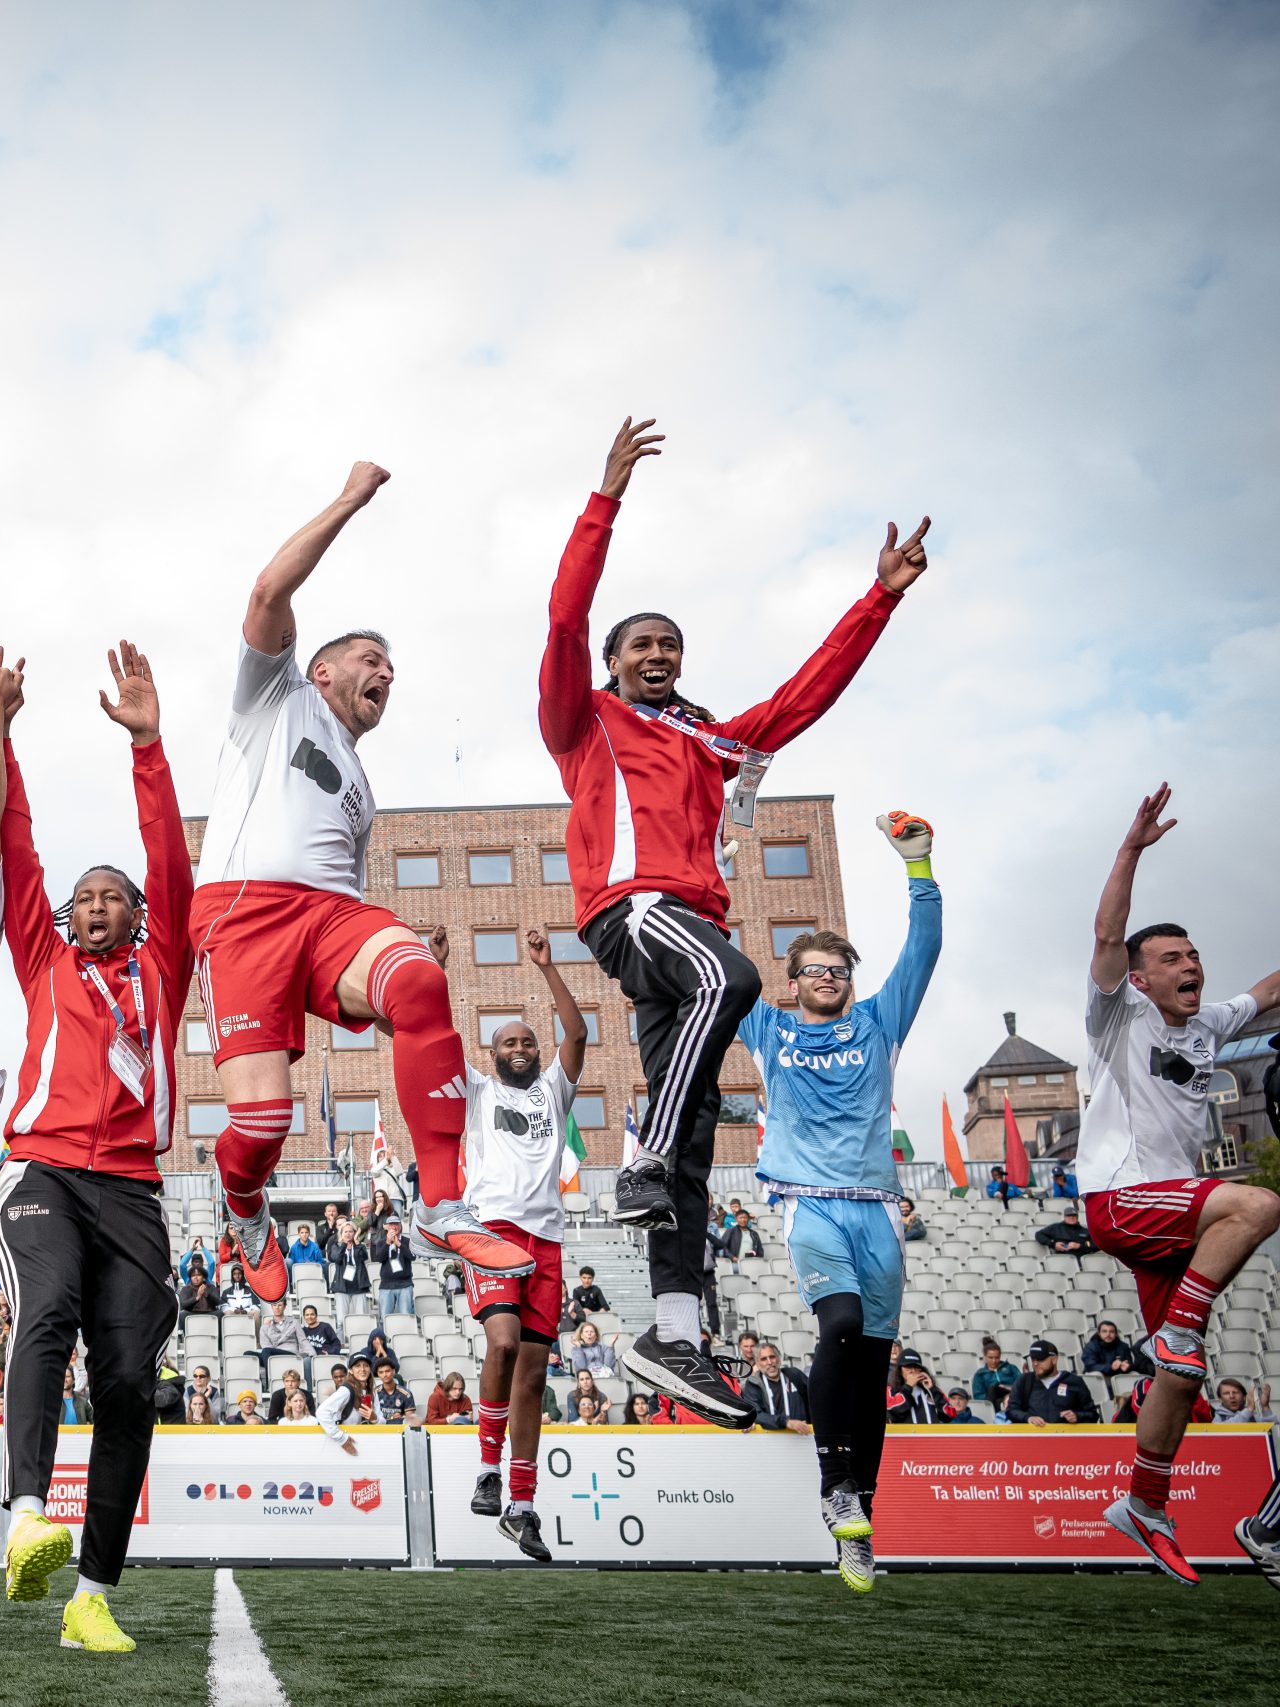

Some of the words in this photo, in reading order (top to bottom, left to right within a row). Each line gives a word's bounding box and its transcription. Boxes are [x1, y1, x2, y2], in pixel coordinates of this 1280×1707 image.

[350, 780, 363, 806] THE
[231, 1013, 249, 1023] TEAM
[233, 1020, 261, 1031] ENGLAND
[792, 1049, 865, 1070] cuvva
[528, 1112, 544, 1122] THE
[900, 1461, 974, 1476] Nærmere
[979, 1461, 1008, 1475] 400
[1012, 1461, 1049, 1475] barn
[1054, 1463, 1110, 1480] trenger
[186, 1482, 252, 1500] OSLO
[263, 1481, 334, 1507] 2025
[657, 1489, 699, 1503] Punkt
[703, 1489, 734, 1503] Oslo
[931, 1486, 949, 1500] Ta
[953, 1486, 999, 1500] ballen!
[1005, 1486, 1023, 1500] Bli
[1028, 1486, 1108, 1504] spesialisert
[263, 1506, 314, 1515] NORWAY
